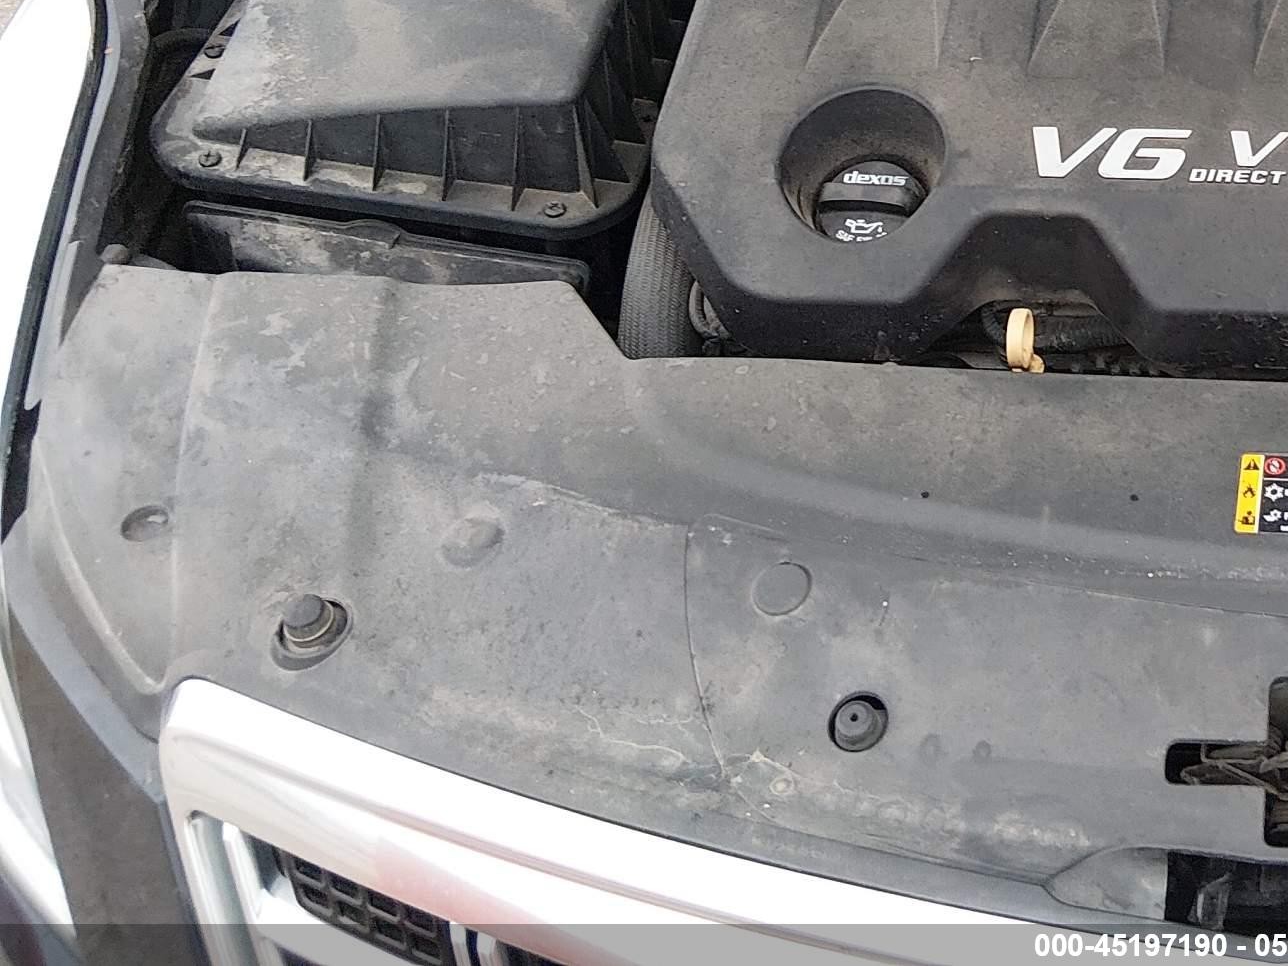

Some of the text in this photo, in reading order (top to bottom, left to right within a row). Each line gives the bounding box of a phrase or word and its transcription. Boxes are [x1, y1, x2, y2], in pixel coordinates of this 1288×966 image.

[1032, 126, 1193, 180] V6
[843, 170, 909, 186] dexos
[1188, 168, 1287, 186] DIRECT
